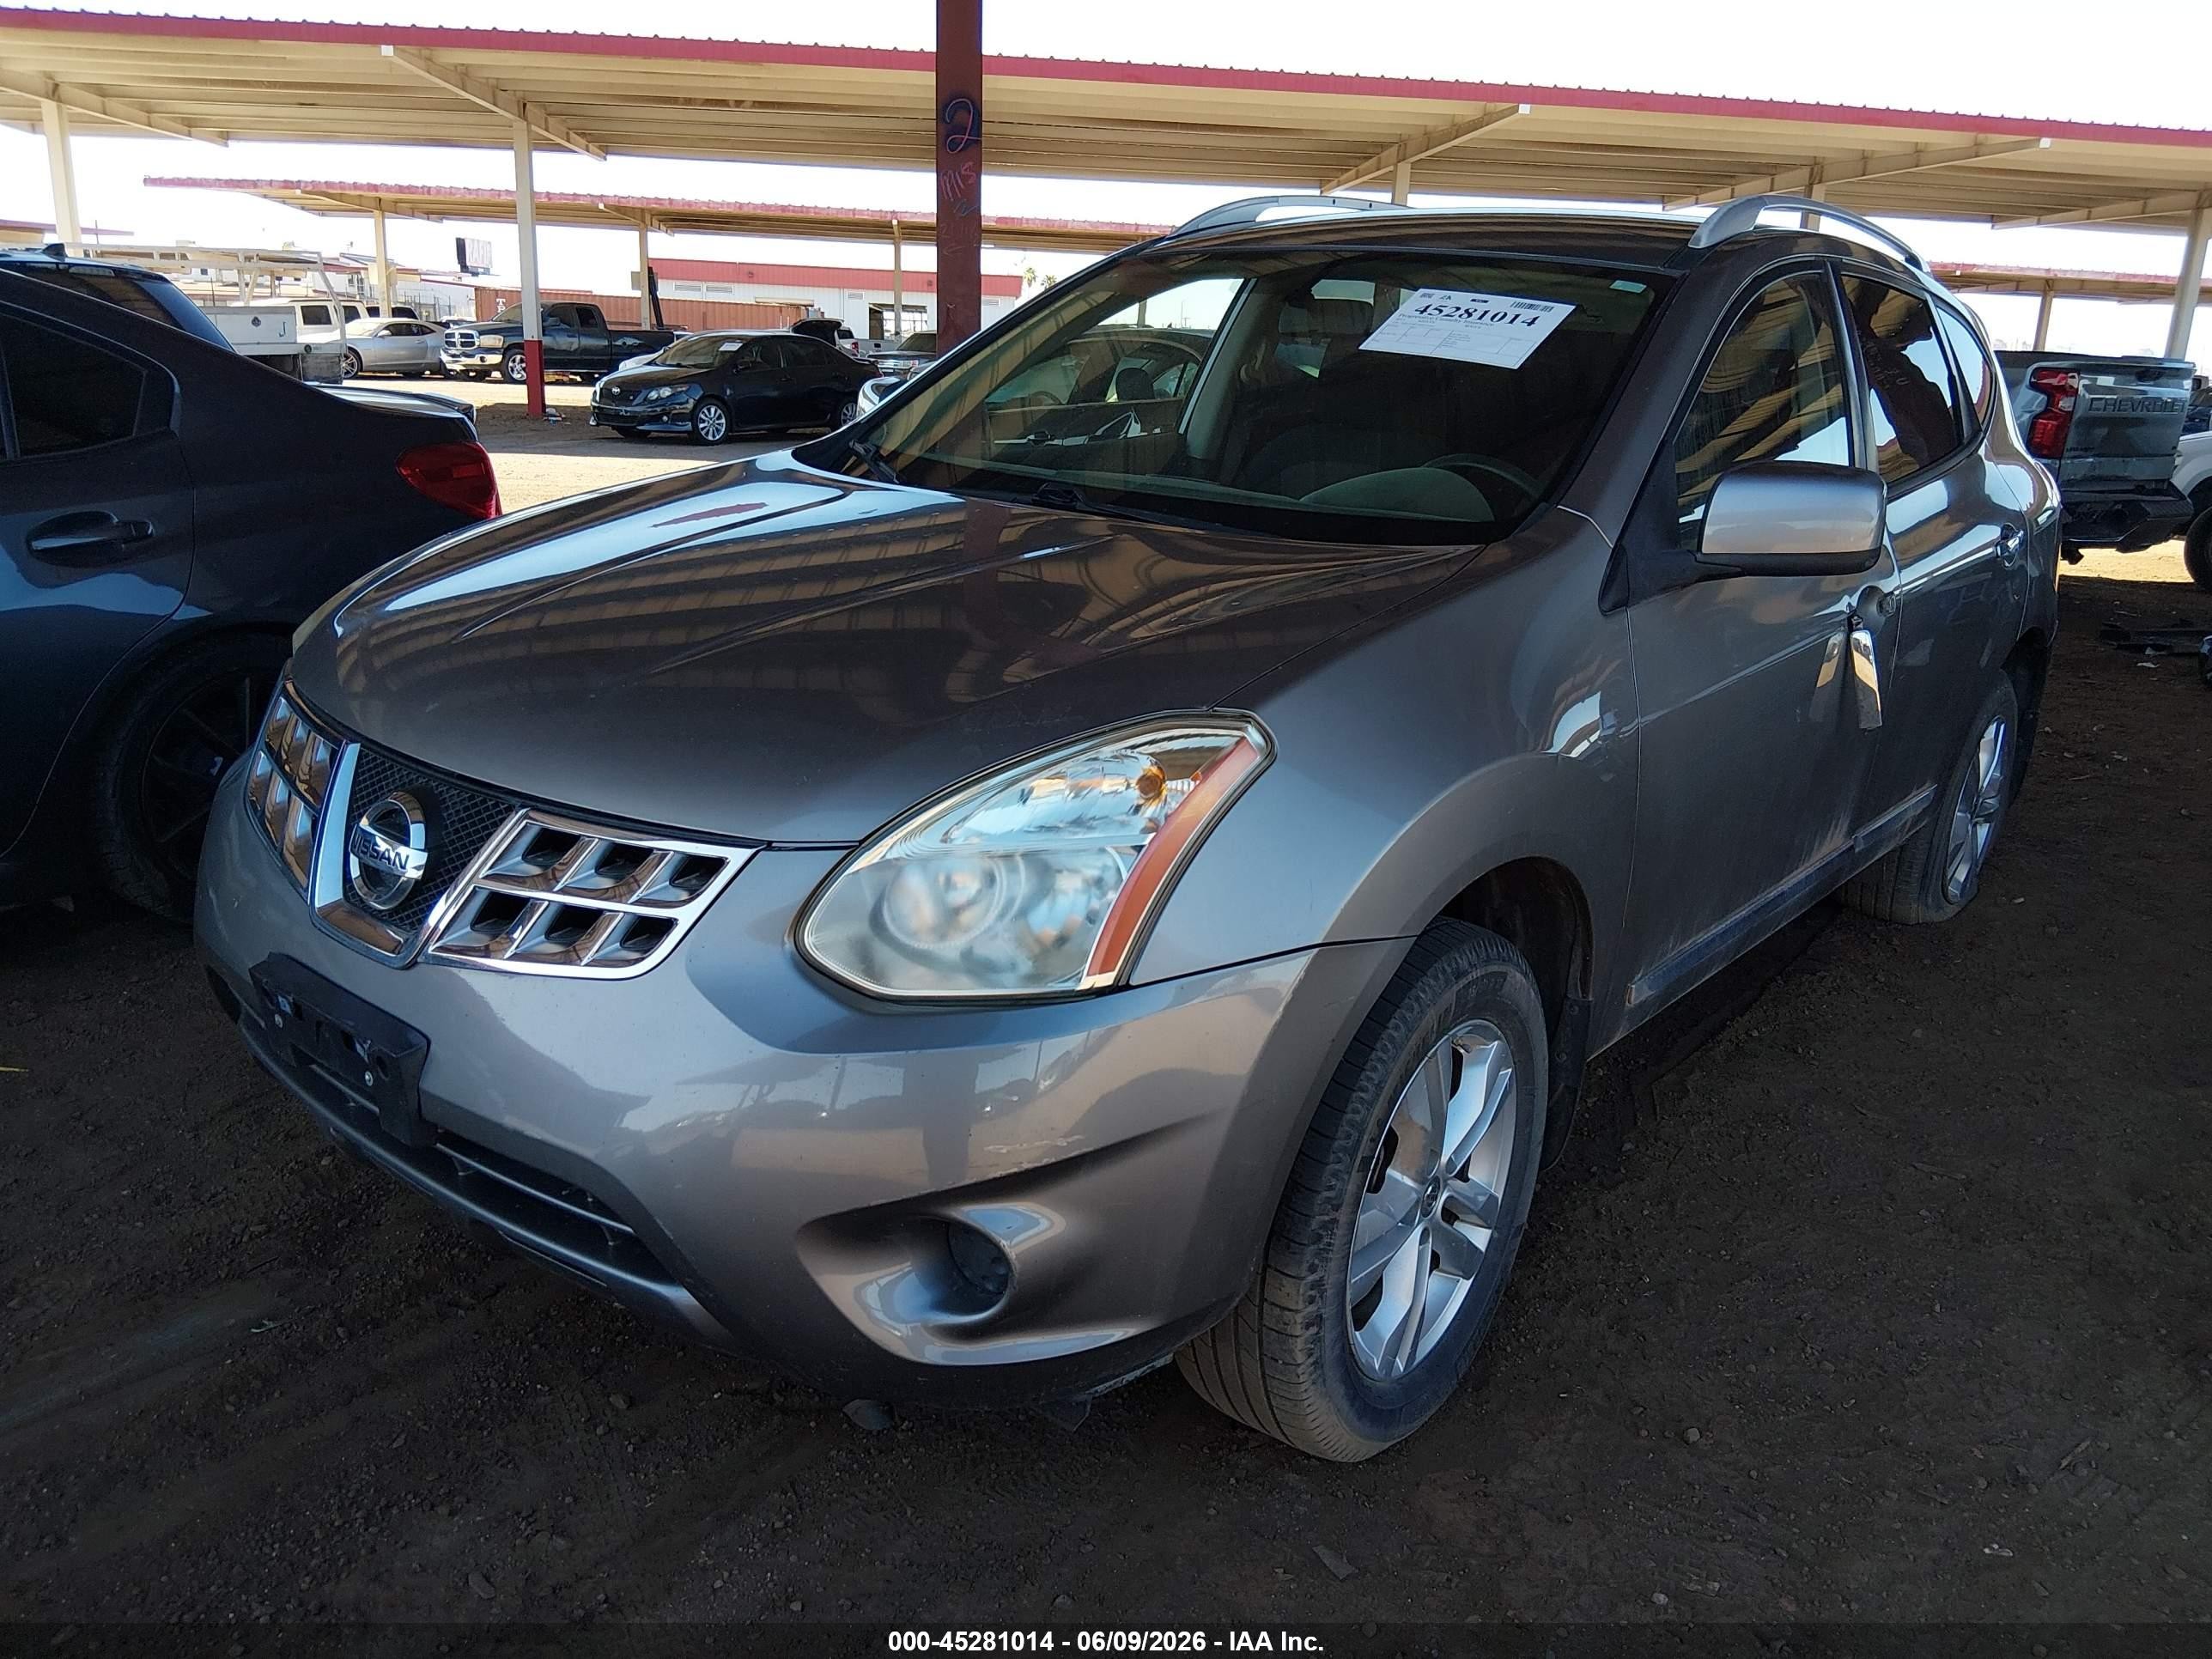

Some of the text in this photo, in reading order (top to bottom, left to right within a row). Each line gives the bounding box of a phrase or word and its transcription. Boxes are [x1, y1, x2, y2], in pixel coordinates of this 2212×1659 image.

[945, 97, 981, 154] 2
[1414, 303, 1540, 327] 45281014
[2088, 396, 2185, 413] CHEVROLET
[352, 833, 410, 872] NISSAN
